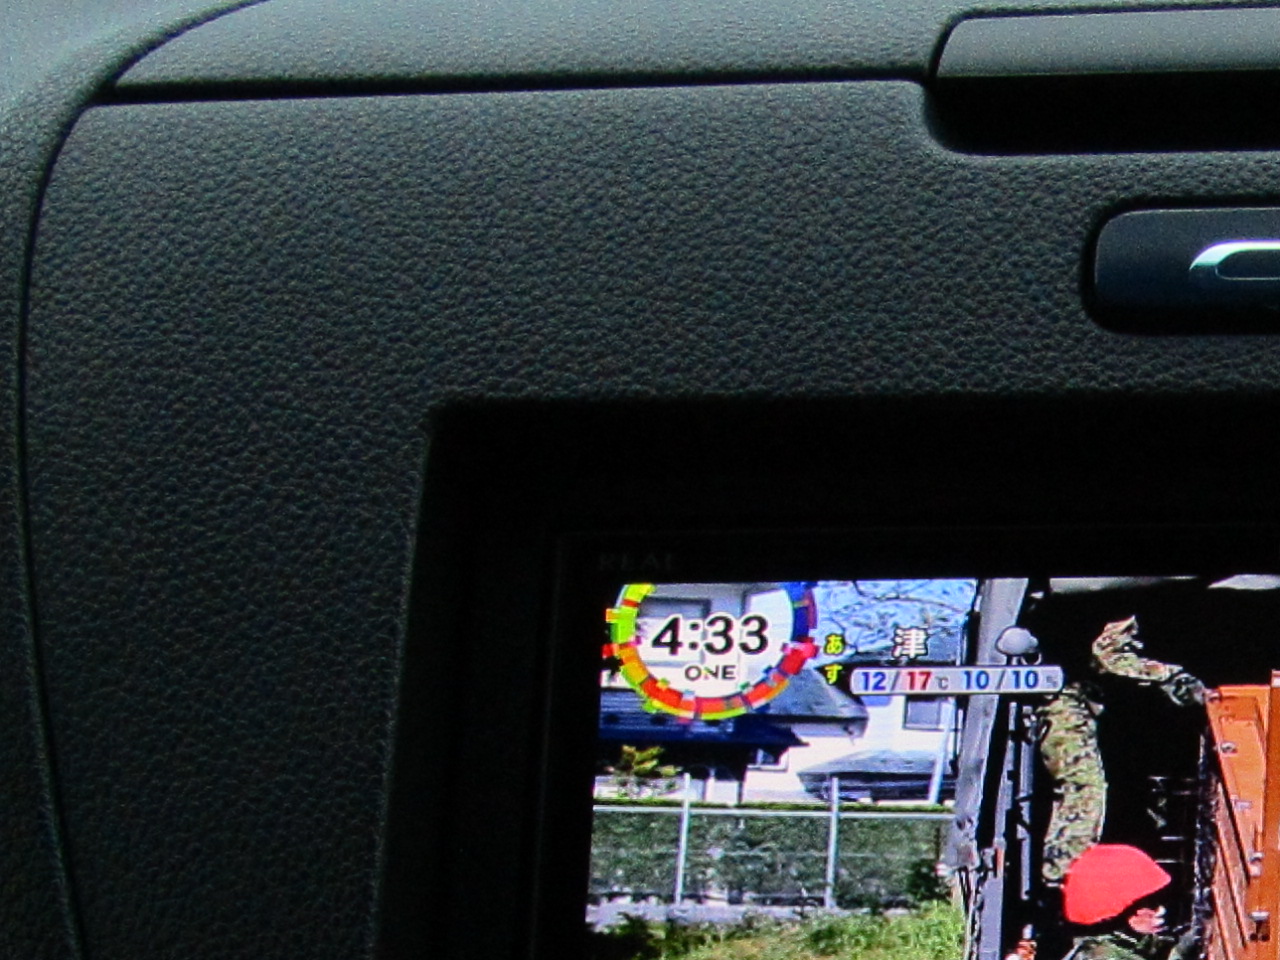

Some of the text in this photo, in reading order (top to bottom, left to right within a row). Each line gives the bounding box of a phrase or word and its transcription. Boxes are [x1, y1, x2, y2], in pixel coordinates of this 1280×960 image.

[651, 613, 770, 657] 4:33
[891, 626, 929, 660] 津
[683, 662, 738, 683] ONE
